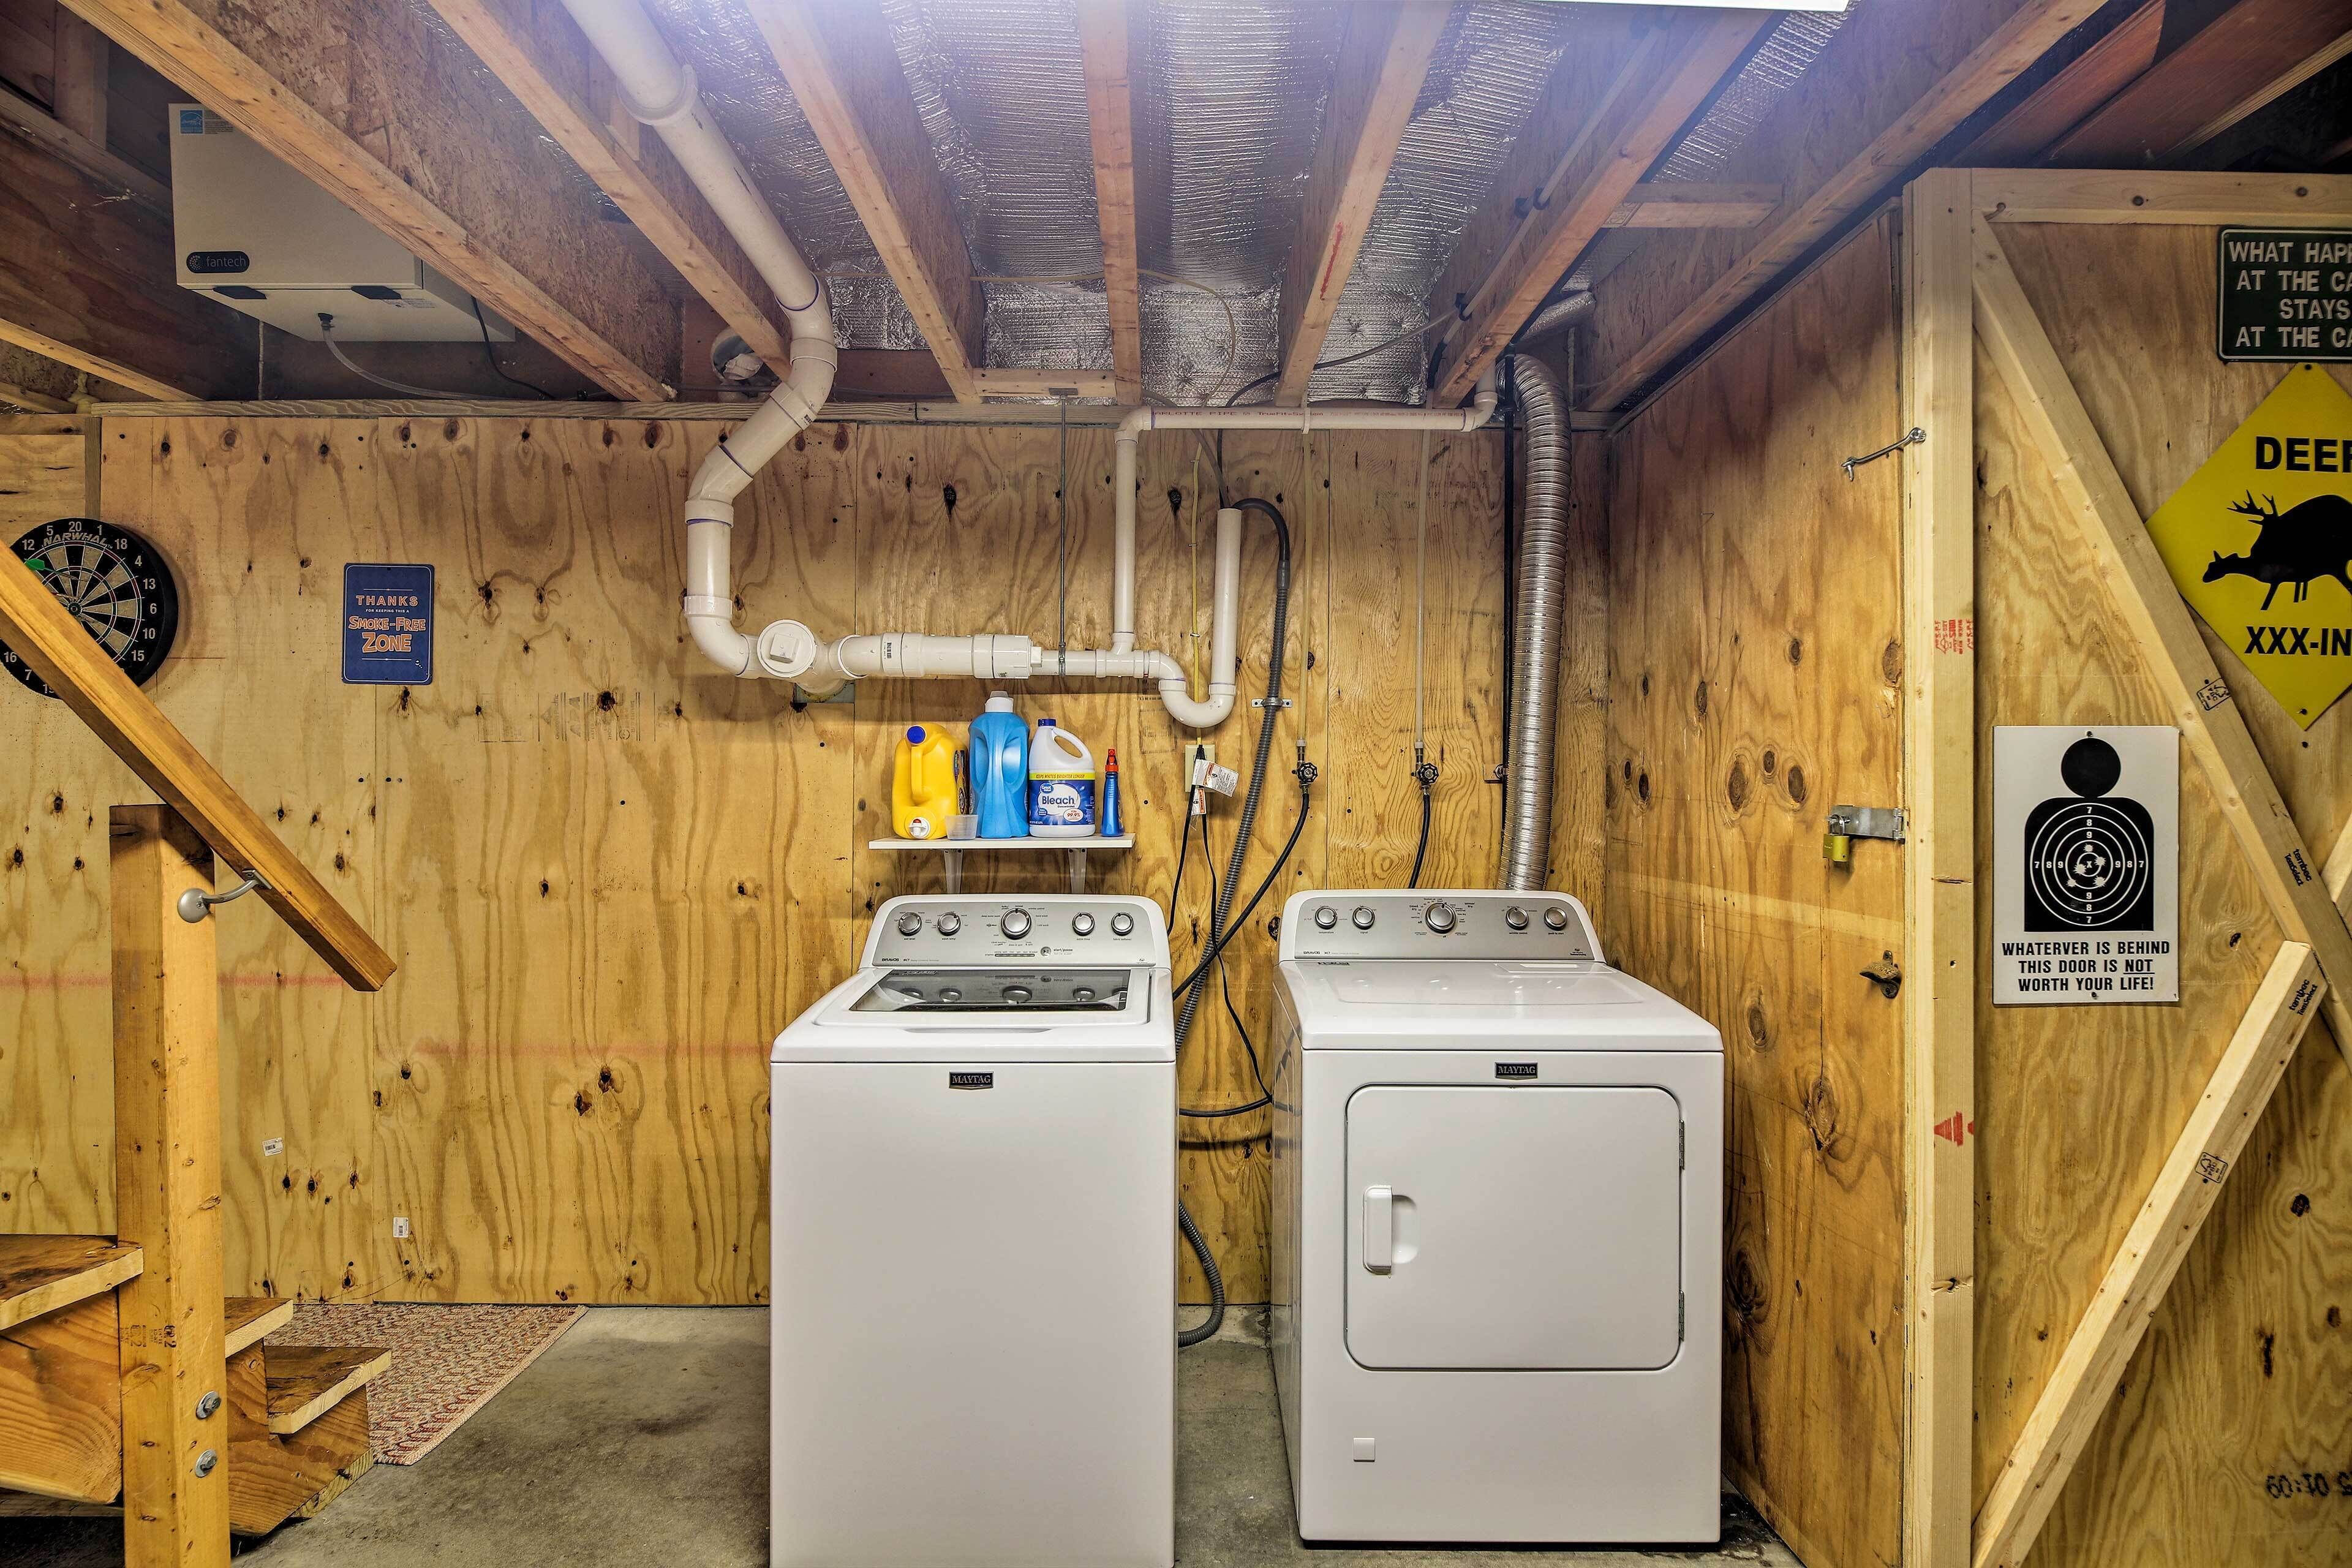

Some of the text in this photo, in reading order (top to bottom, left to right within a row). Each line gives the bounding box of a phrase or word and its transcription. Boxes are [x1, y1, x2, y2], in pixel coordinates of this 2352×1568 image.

[2228, 241, 2294, 263] WHAT
[206, 255, 246, 268] fantech
[2236, 270, 2266, 291] AT
[2278, 270, 2320, 292] THE
[2280, 298, 2351, 320] STAYS
[2235, 326, 2266, 347] AT
[2278, 326, 2320, 348] THE
[47, 525, 54, 535] 5
[69, 521, 82, 532] 20
[97, 524, 103, 535] 1
[22, 540, 35, 550] 12
[42, 533, 108, 548] NARWHAL
[115, 538, 128, 550] 18
[134, 556, 143, 566] 4
[143, 578, 156, 589] 13
[356, 595, 418, 606] THANKS
[150, 603, 157, 614] 6
[349, 616, 426, 631] SMOKE-FREE
[143, 628, 156, 639] 10
[362, 632, 412, 653] ZONE
[4, 652, 17, 663] 16
[132, 650, 145, 662] 15
[24, 669, 32, 680] 7
[1042, 796, 1074, 805] Bleach
[2293, 849, 2312, 881] tembec
[2002, 941, 2169, 956] WHATERVER IS BEHIND
[2018, 959, 2153, 974] THIS DOOR IS NOT
[2018, 977, 2154, 992] WORTH YOUR LIFE!
[2289, 979, 2310, 1011] tembec
[952, 1075, 990, 1084] MAYTAG
